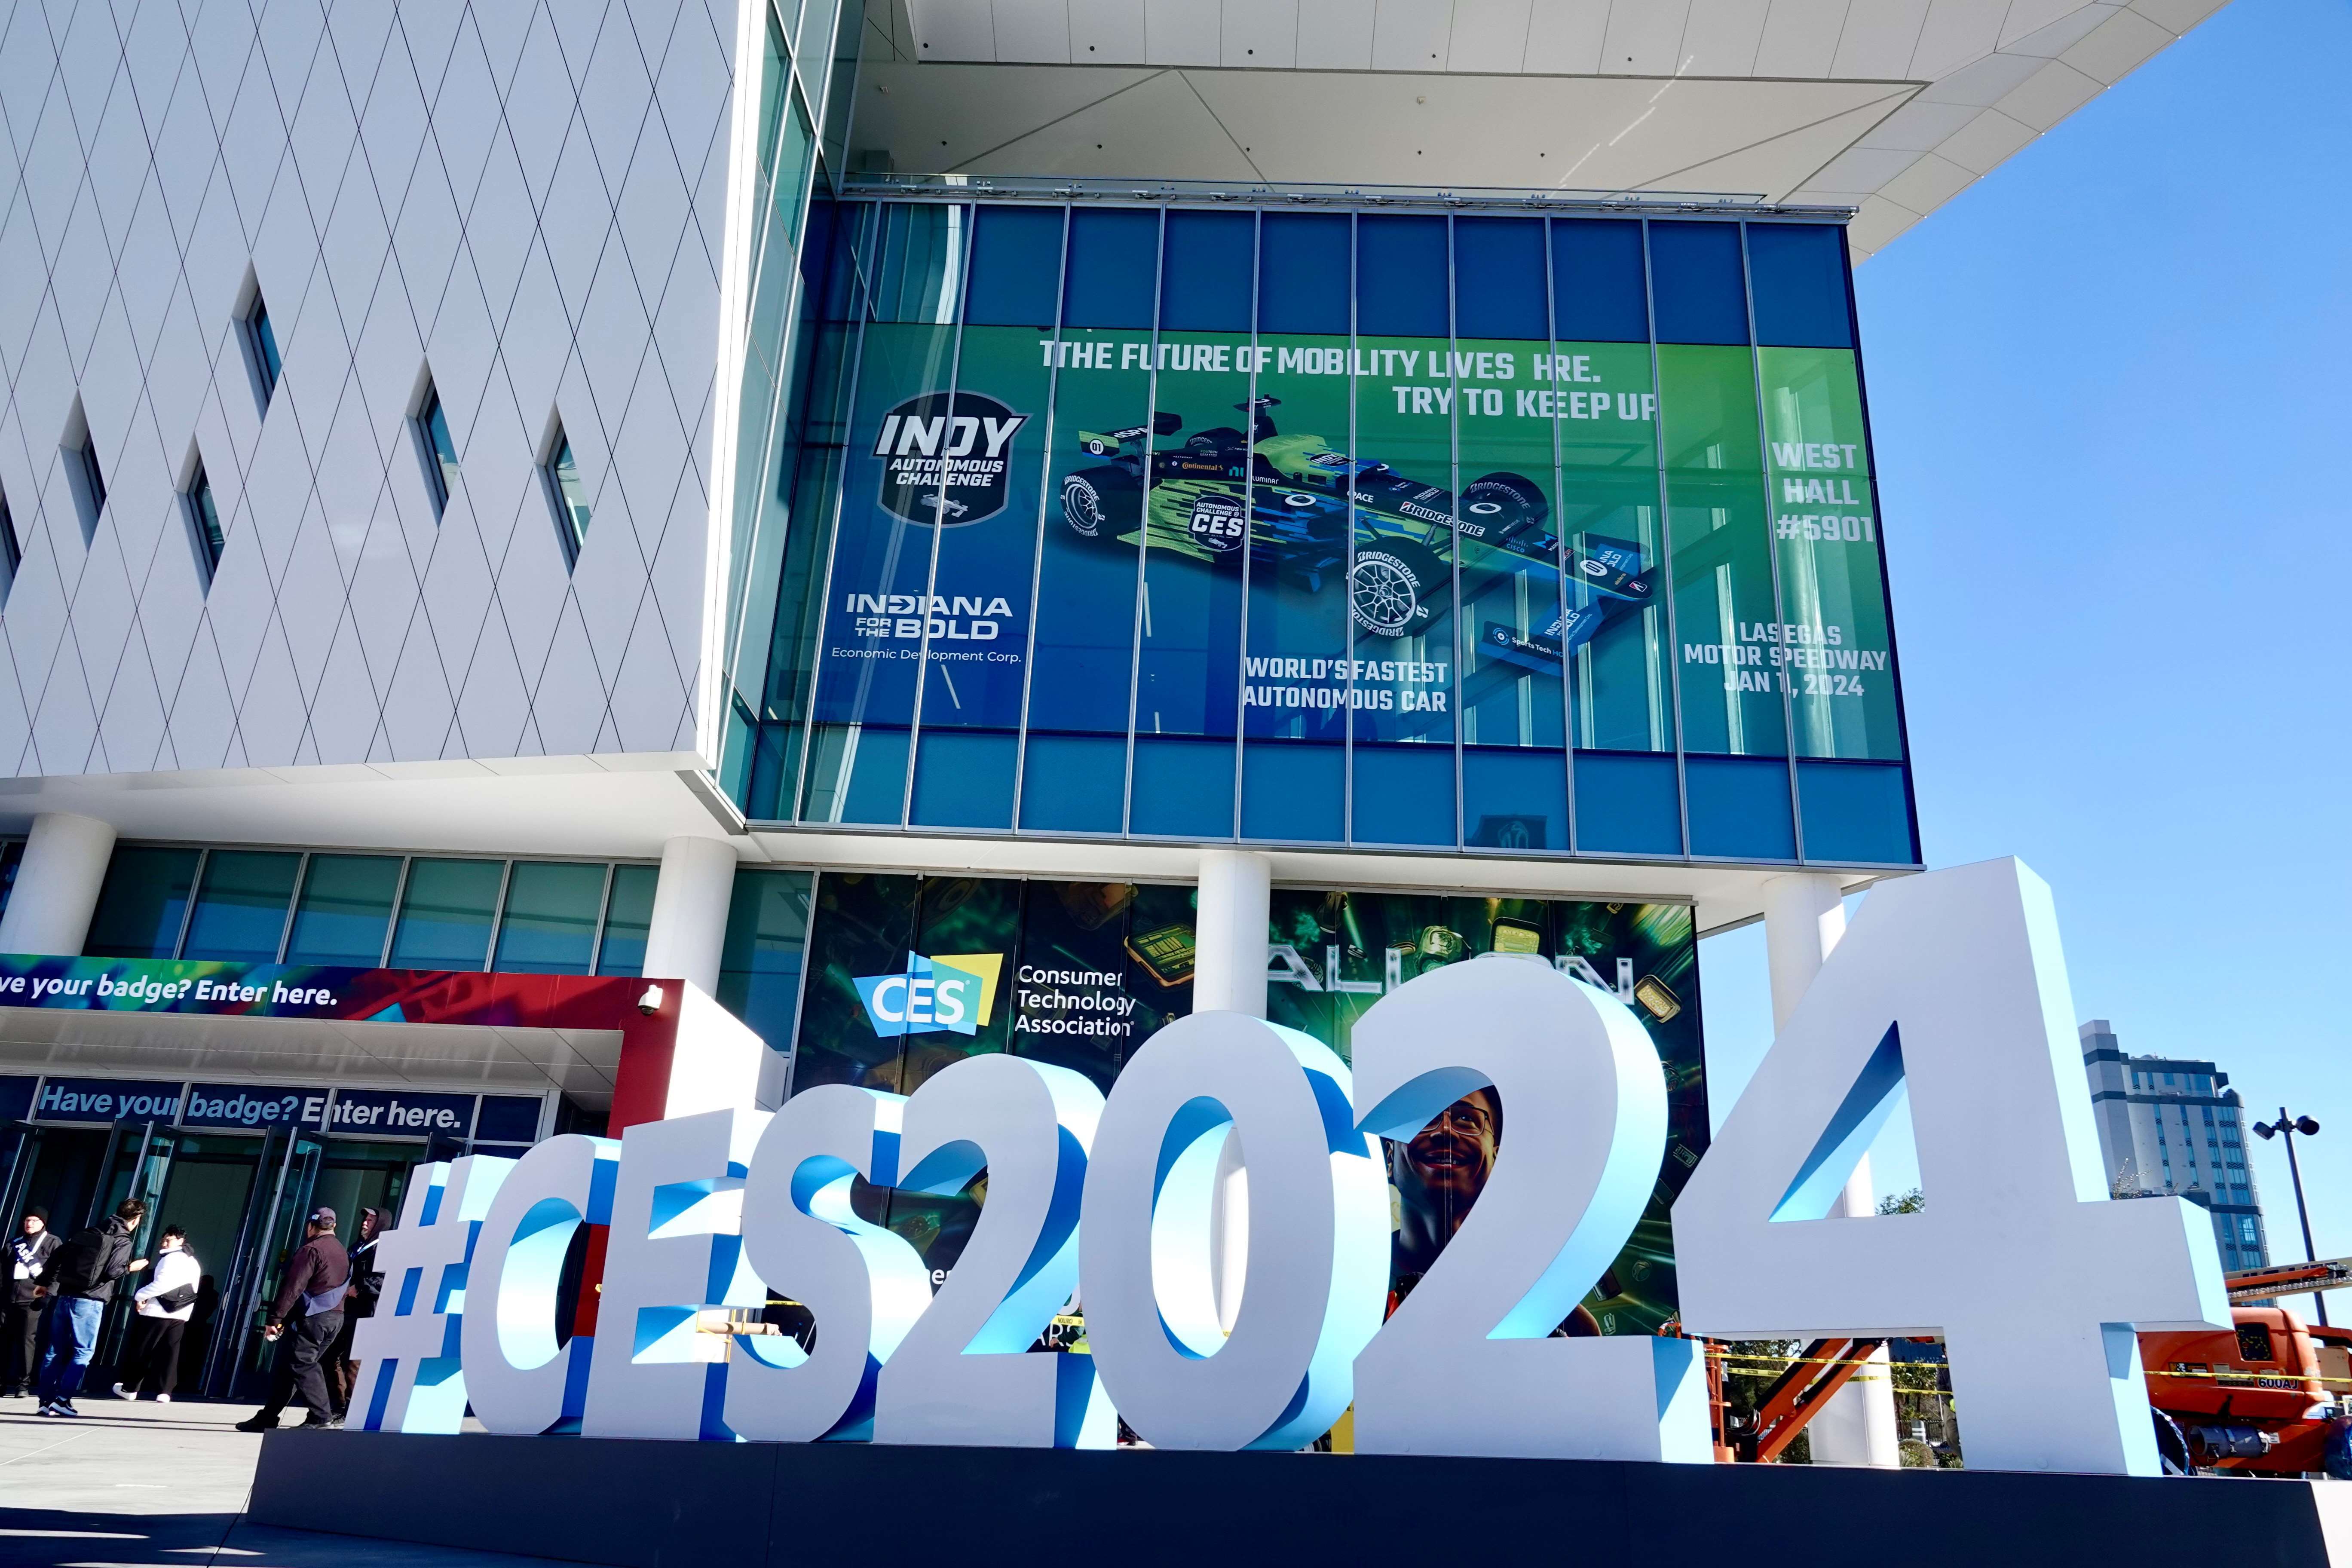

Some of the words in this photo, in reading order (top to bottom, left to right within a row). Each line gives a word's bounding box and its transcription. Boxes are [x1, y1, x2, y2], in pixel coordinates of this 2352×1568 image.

[1121, 343, 1230, 371] FUTURE
[1236, 346, 1272, 373] OF
[1278, 347, 1420, 376] MOBILITY
[1429, 351, 1514, 379] LIVES
[1392, 386, 1452, 414] TRY
[1463, 389, 1503, 416] TO
[876, 415, 1023, 457] INDY
[1092, 443, 1101, 452] 01
[889, 459, 1004, 472] AUTONOMOUS
[1182, 462, 1218, 471] Continental
[1311, 453, 1338, 464] INDY
[1771, 442, 1856, 469] WEST
[896, 473, 994, 486] CHALENGE
[1064, 475, 1100, 501] BRIDGESTONE
[1783, 478, 1859, 505] HALL
[1197, 502, 1239, 511] AUTONOMOUS
[1470, 482, 1531, 509] BRIDGESTONE
[1192, 514, 1243, 536] CES
[1196, 508, 1232, 516] CHALLENGE
[1400, 501, 1485, 537] BRIDGESONE
[1776, 514, 1874, 542] #5901
[1357, 551, 1421, 588] BRIDGESTONE
[846, 594, 1013, 617] INDIANA
[855, 628, 889, 637] THE
[895, 619, 998, 640] BOLD
[856, 617, 891, 627] FOR
[832, 647, 897, 659] Economic
[901, 649, 983, 662] Delopment
[987, 651, 1021, 664] Corp.
[1512, 637, 1535, 649] Sports
[1535, 644, 1551, 654] Tech
[1684, 644, 1762, 666] MOTOR
[1770, 646, 1886, 671] SPEEDWAY
[1246, 657, 1347, 680] WORLD'S
[1353, 660, 1448, 683] FASTEST
[1724, 670, 1770, 692] JAN
[1804, 674, 1865, 696] 2024
[1243, 686, 1393, 710] AUTONOMOUS
[1401, 690, 1447, 712] CAR
[1019, 965, 1123, 986] Consumer
[31, 977, 93, 999] your
[97, 973, 192, 1004] badge?
[195, 980, 268, 1002] Enter
[271, 980, 337, 1006] here.
[872, 977, 965, 1025] CES
[1018, 989, 1136, 1016] Technology
[39, 1086, 113, 1113] Have
[115, 1096, 180, 1119] your
[187, 1092, 299, 1125] badge?
[301, 1097, 384, 1124] Enter
[387, 1100, 462, 1128] here.
[344, 855, 2234, 1476] #CES2024
[2258, 1378, 2298, 1390] 600AJ
